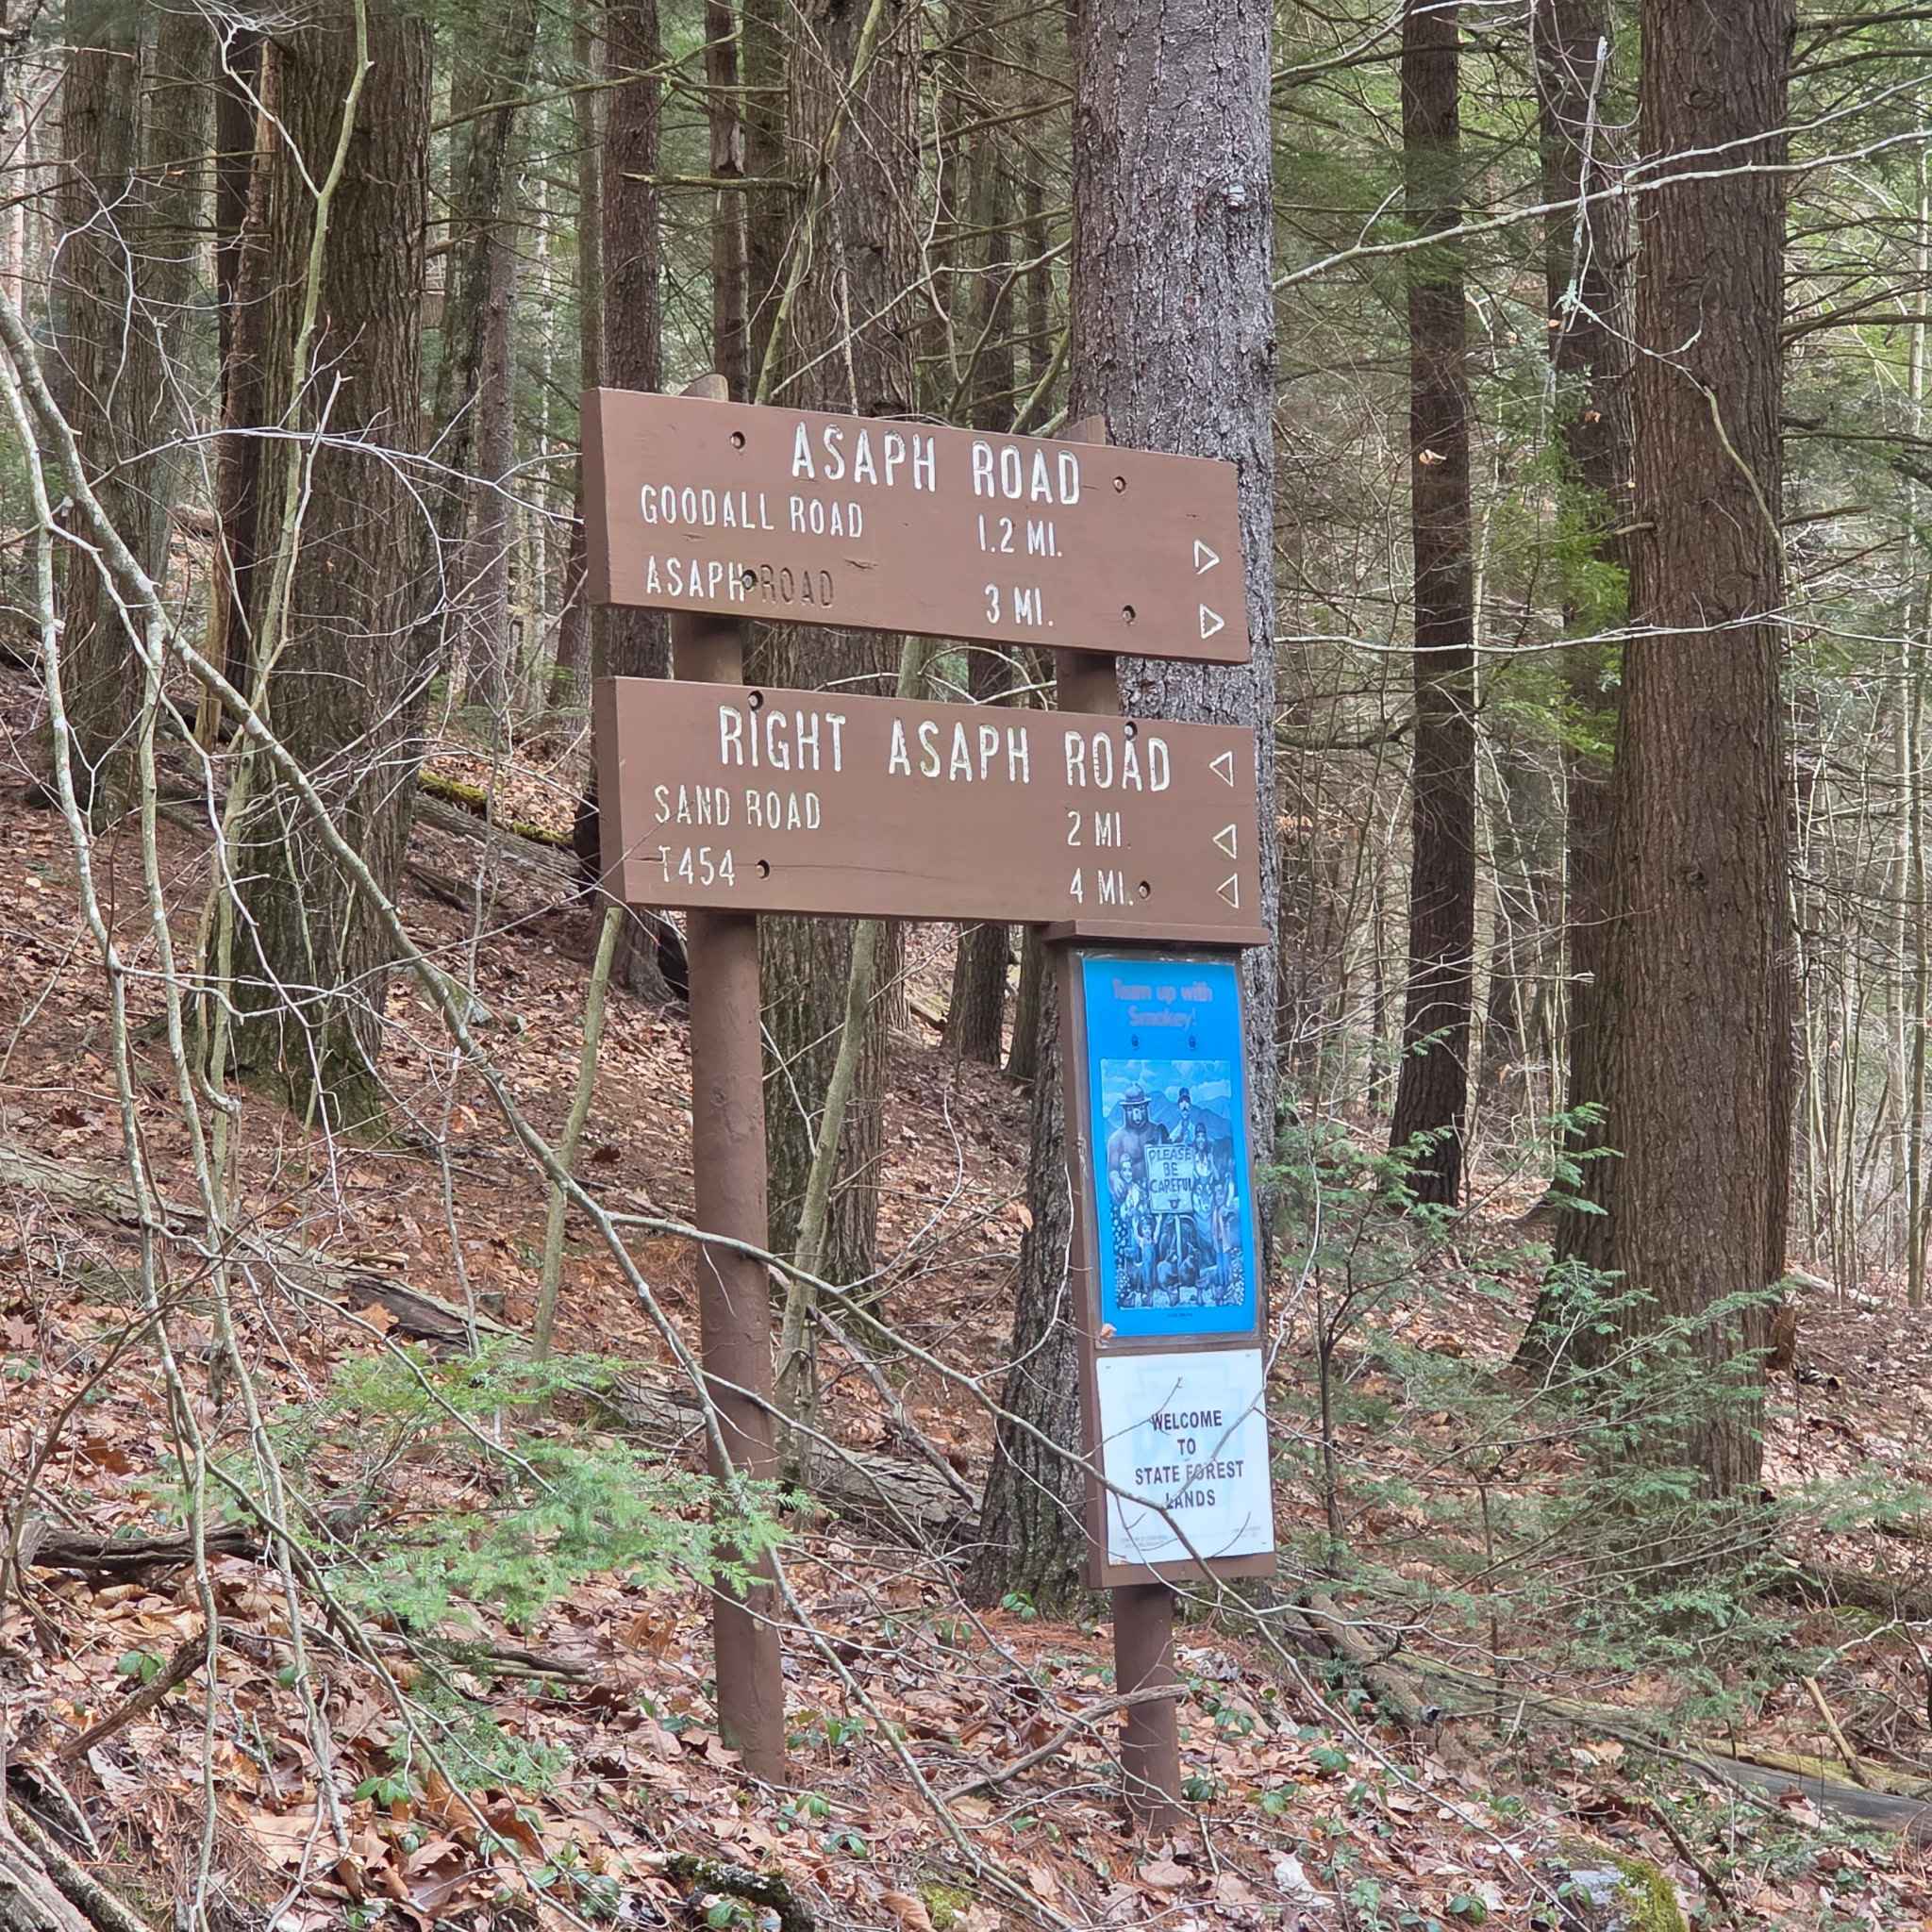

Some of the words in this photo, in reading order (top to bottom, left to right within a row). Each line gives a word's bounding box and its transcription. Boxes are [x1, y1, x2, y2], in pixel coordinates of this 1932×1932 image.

[791, 422, 937, 492] ASAPH
[972, 440, 1081, 507] ROAD
[640, 484, 774, 532] GOODALL
[790, 496, 863, 540] ROAD
[978, 513, 1015, 553] 1.2
[1026, 520, 1063, 558] MI.
[646, 556, 745, 604] ASAPH
[759, 563, 834, 608] ROAD
[984, 583, 1000, 625] 3
[1013, 586, 1054, 627] MI.
[719, 705, 847, 773] RIGHT
[888, 717, 1030, 784] ASAPH
[1066, 730, 1171, 792] ROAD
[654, 784, 730, 826] SAND
[746, 789, 821, 830] ROAD
[1067, 810, 1082, 846] 2
[658, 844, 735, 887] T454
[1069, 867, 1083, 904] 4
[1097, 869, 1134, 906] MI.
[1148, 1147, 1192, 1163] PLEASE
[1162, 1161, 1179, 1176] BE
[1151, 1409, 1223, 1432] WELCOME
[1176, 1438, 1197, 1456] TO
[1135, 1465, 1181, 1486] STATE
[1185, 1459, 1244, 1481] FOREST
[1165, 1489, 1216, 1509] LANDS
